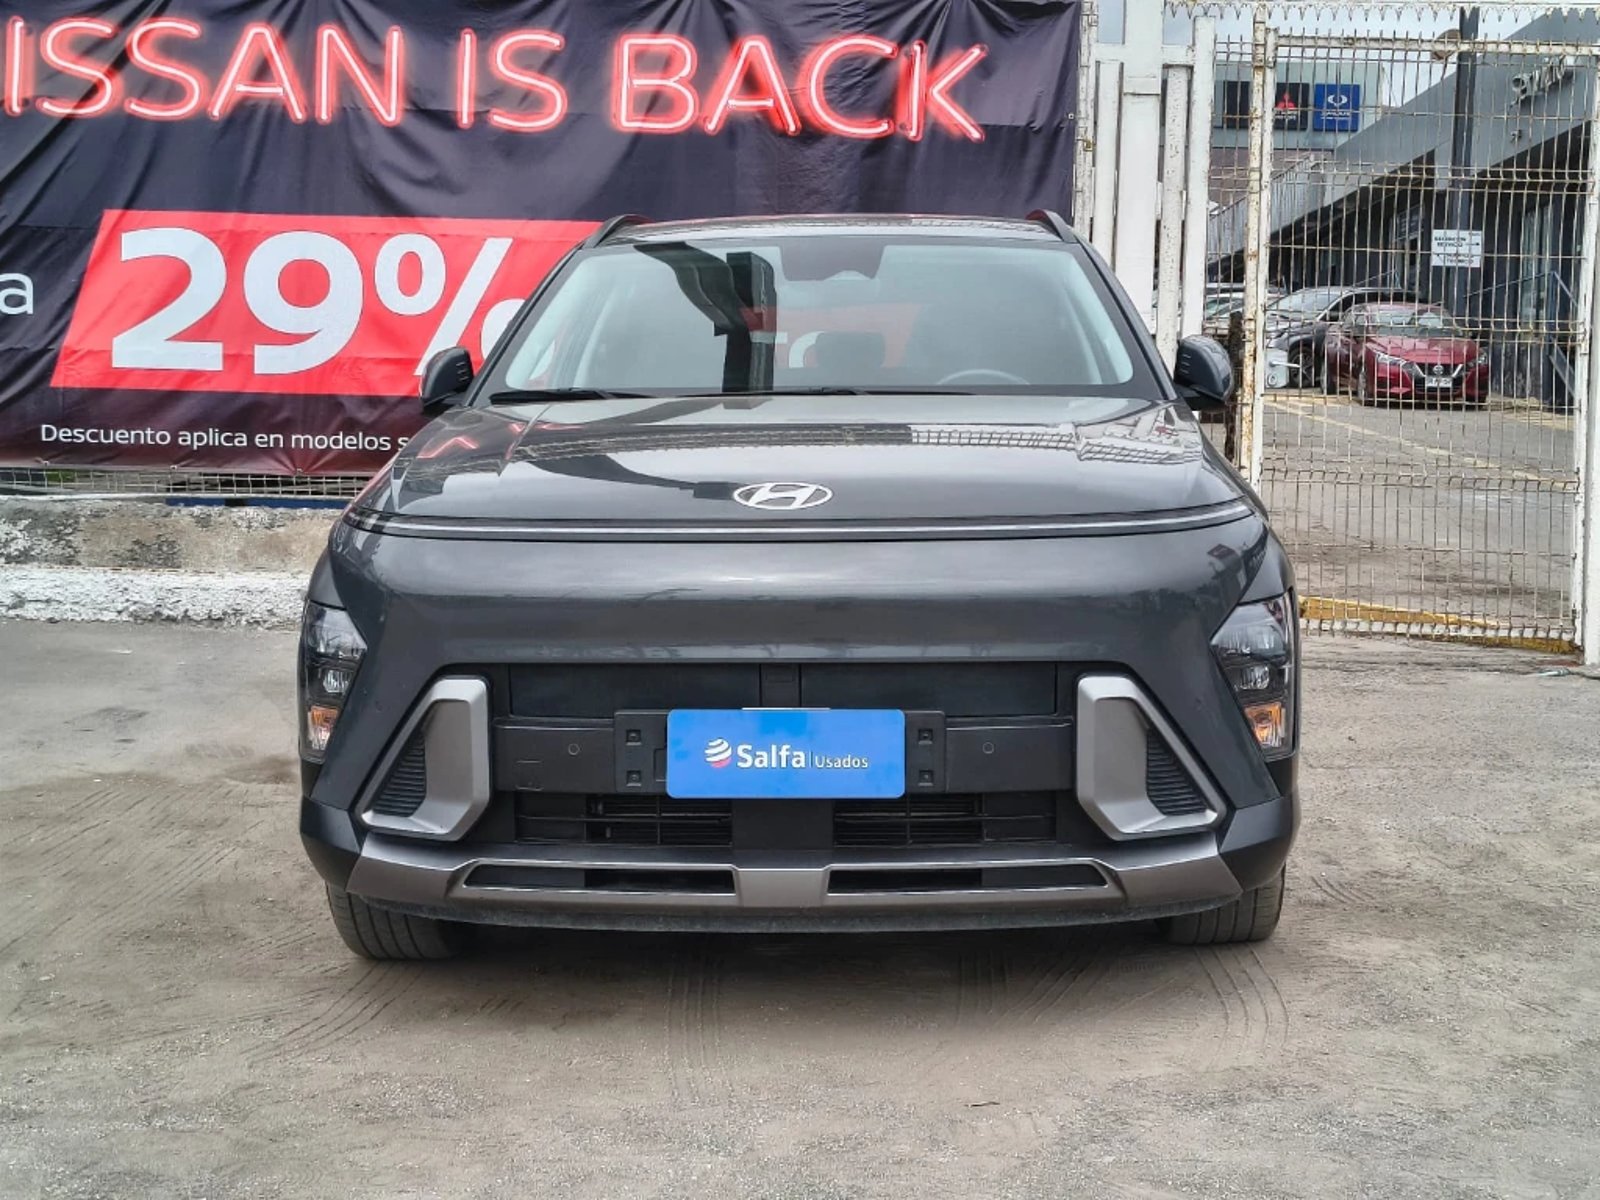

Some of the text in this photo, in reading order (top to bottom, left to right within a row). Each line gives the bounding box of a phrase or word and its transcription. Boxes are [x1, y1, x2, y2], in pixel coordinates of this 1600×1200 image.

[5, 16, 987, 143] ISSAN IS BACK
[110, 227, 527, 376] 29%
[40, 424, 171, 446] Descuento
[178, 427, 248, 450] aplica
[254, 431, 284, 448] en
[291, 433, 392, 451] modelos
[736, 744, 869, 769] Salfa Usados
